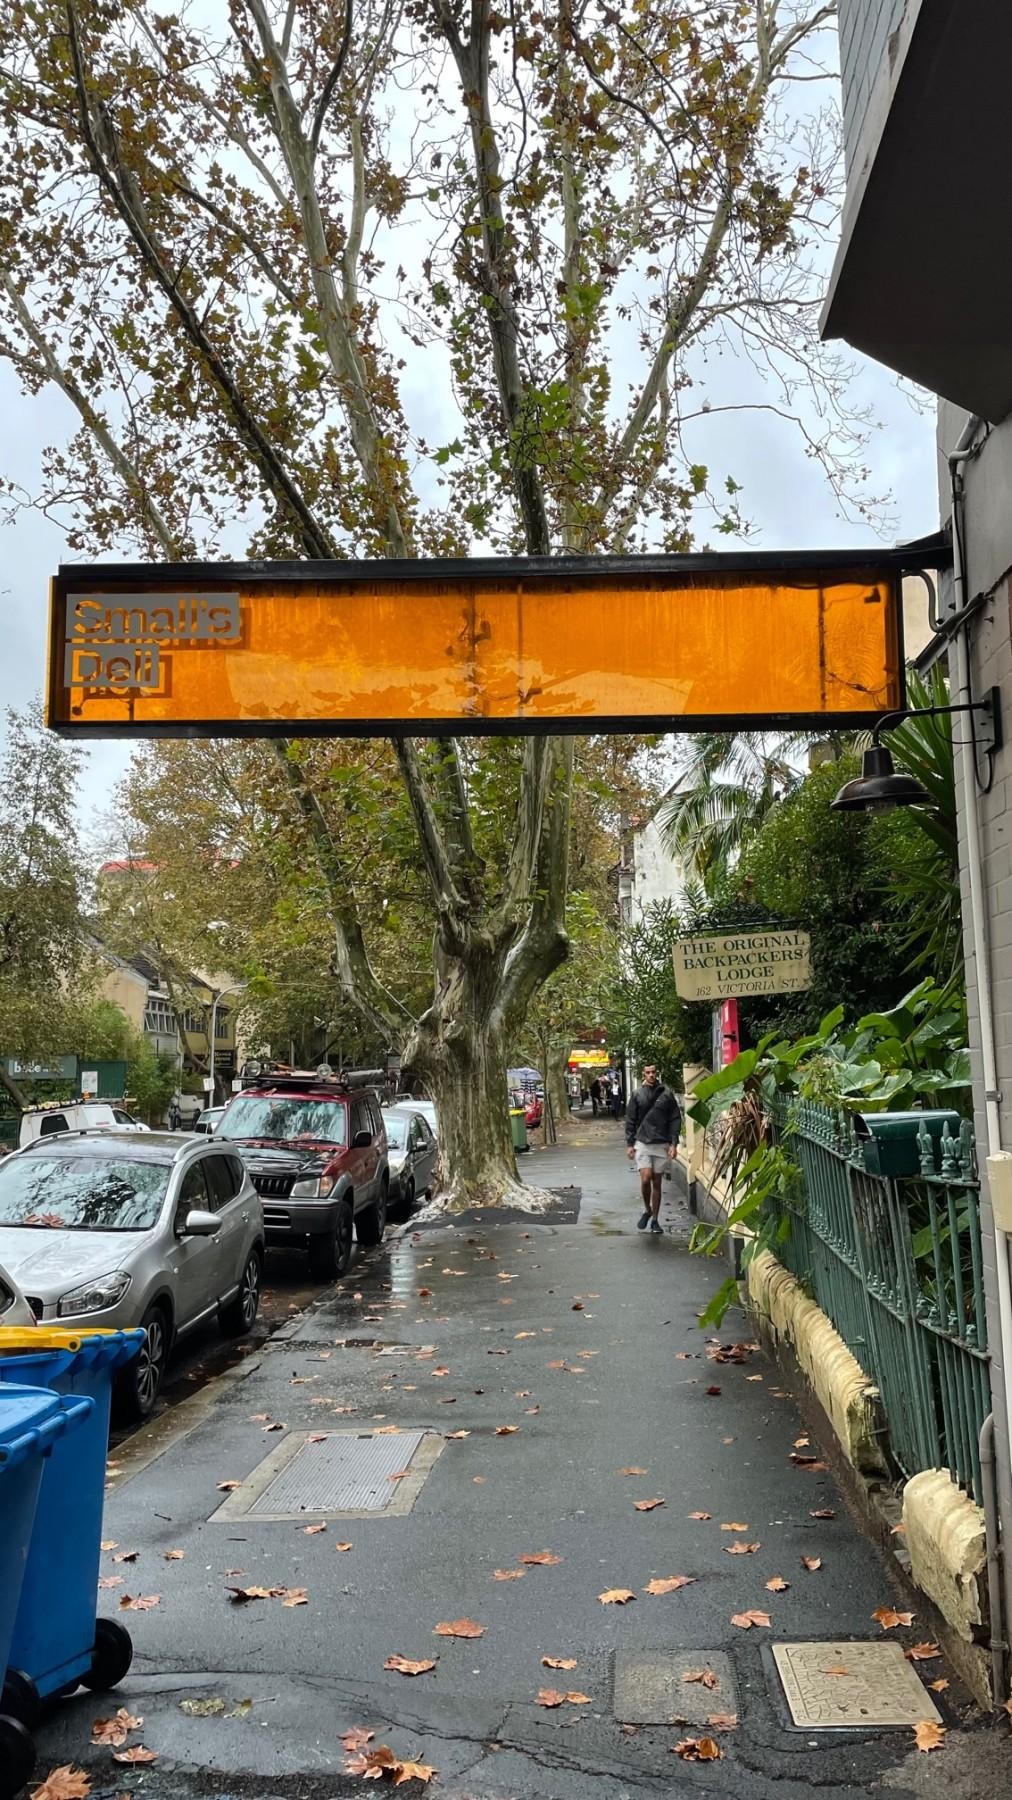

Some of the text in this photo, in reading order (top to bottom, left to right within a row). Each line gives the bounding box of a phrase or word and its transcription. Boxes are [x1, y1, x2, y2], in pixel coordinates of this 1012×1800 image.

[74, 600, 231, 633] Small's
[71, 649, 152, 682] Deli
[680, 935, 805, 955] THE ORIGINAL
[717, 966, 774, 981] LODGE
[696, 987, 711, 996] 162
[718, 980, 775, 995] VICTORIA
